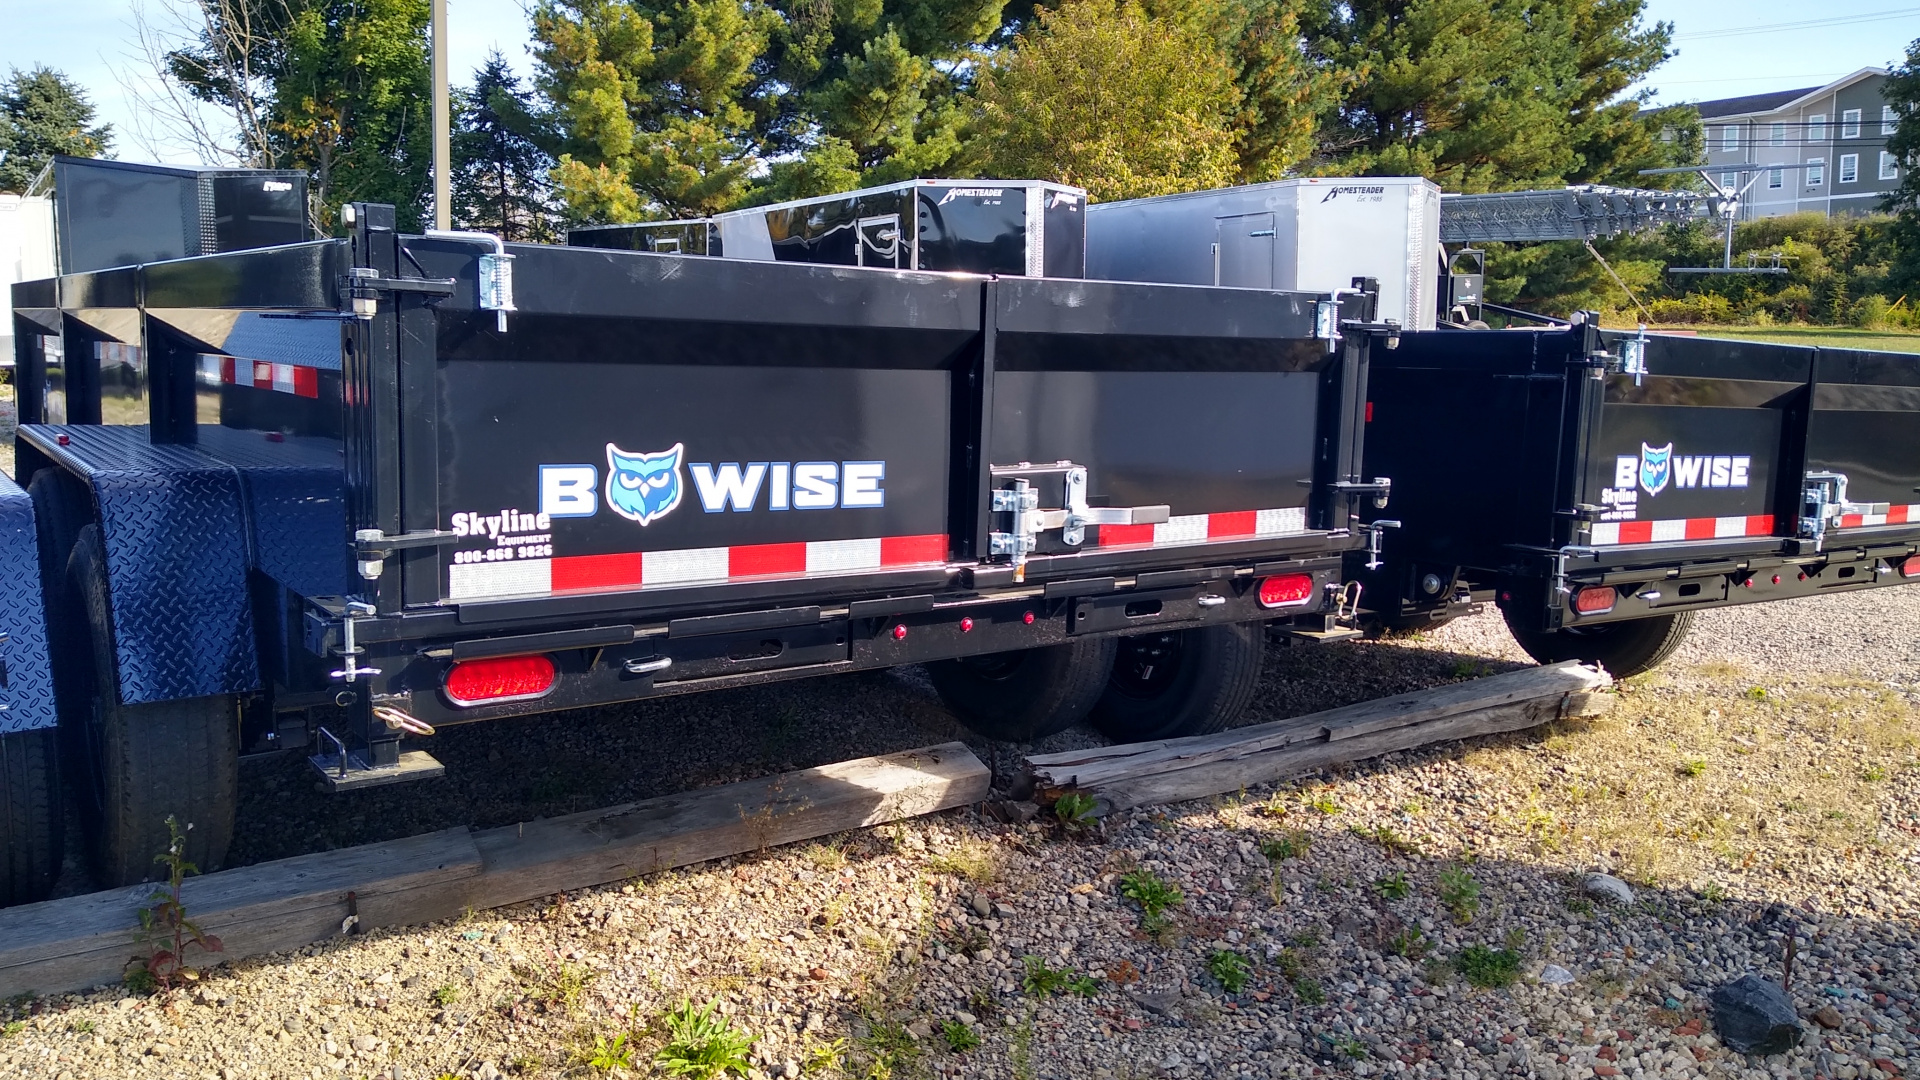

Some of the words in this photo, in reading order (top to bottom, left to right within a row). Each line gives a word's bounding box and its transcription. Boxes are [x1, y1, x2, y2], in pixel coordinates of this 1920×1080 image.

[937, 187, 1003, 206] HOMESTEADER
[1320, 186, 1385, 204] HOMESTEADER
[1601, 487, 1638, 507] Skyline
[451, 508, 551, 540] Skyline
[497, 534, 552, 546] EQUIPMENT
[517, 544, 553, 558] 9826
